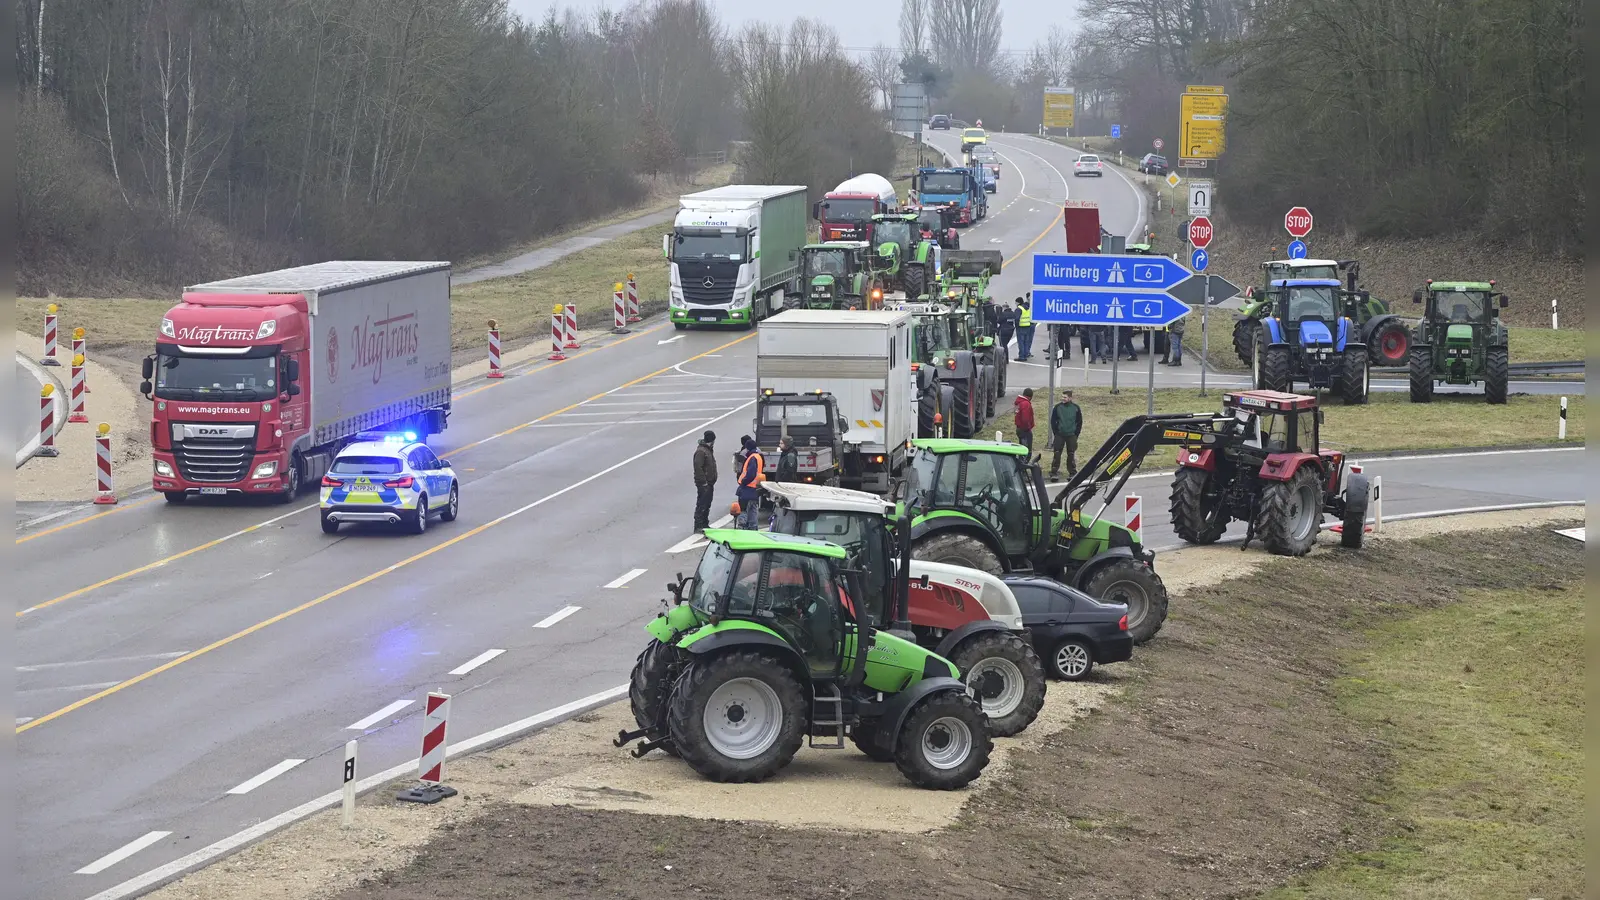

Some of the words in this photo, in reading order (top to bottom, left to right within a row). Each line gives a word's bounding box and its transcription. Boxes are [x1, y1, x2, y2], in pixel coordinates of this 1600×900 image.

[1288, 215, 1310, 228] STOP
[1191, 226, 1210, 239] STOP
[1044, 263, 1099, 282] Nürnberg
[1145, 267, 1152, 279] 6
[1045, 298, 1099, 314] München
[1144, 303, 1151, 315] 6
[178, 324, 255, 344] Magtrans
[350, 302, 419, 384] Magtrans
[178, 406, 250, 415] www.magtrans.eu
[954, 578, 981, 592] STEYR
